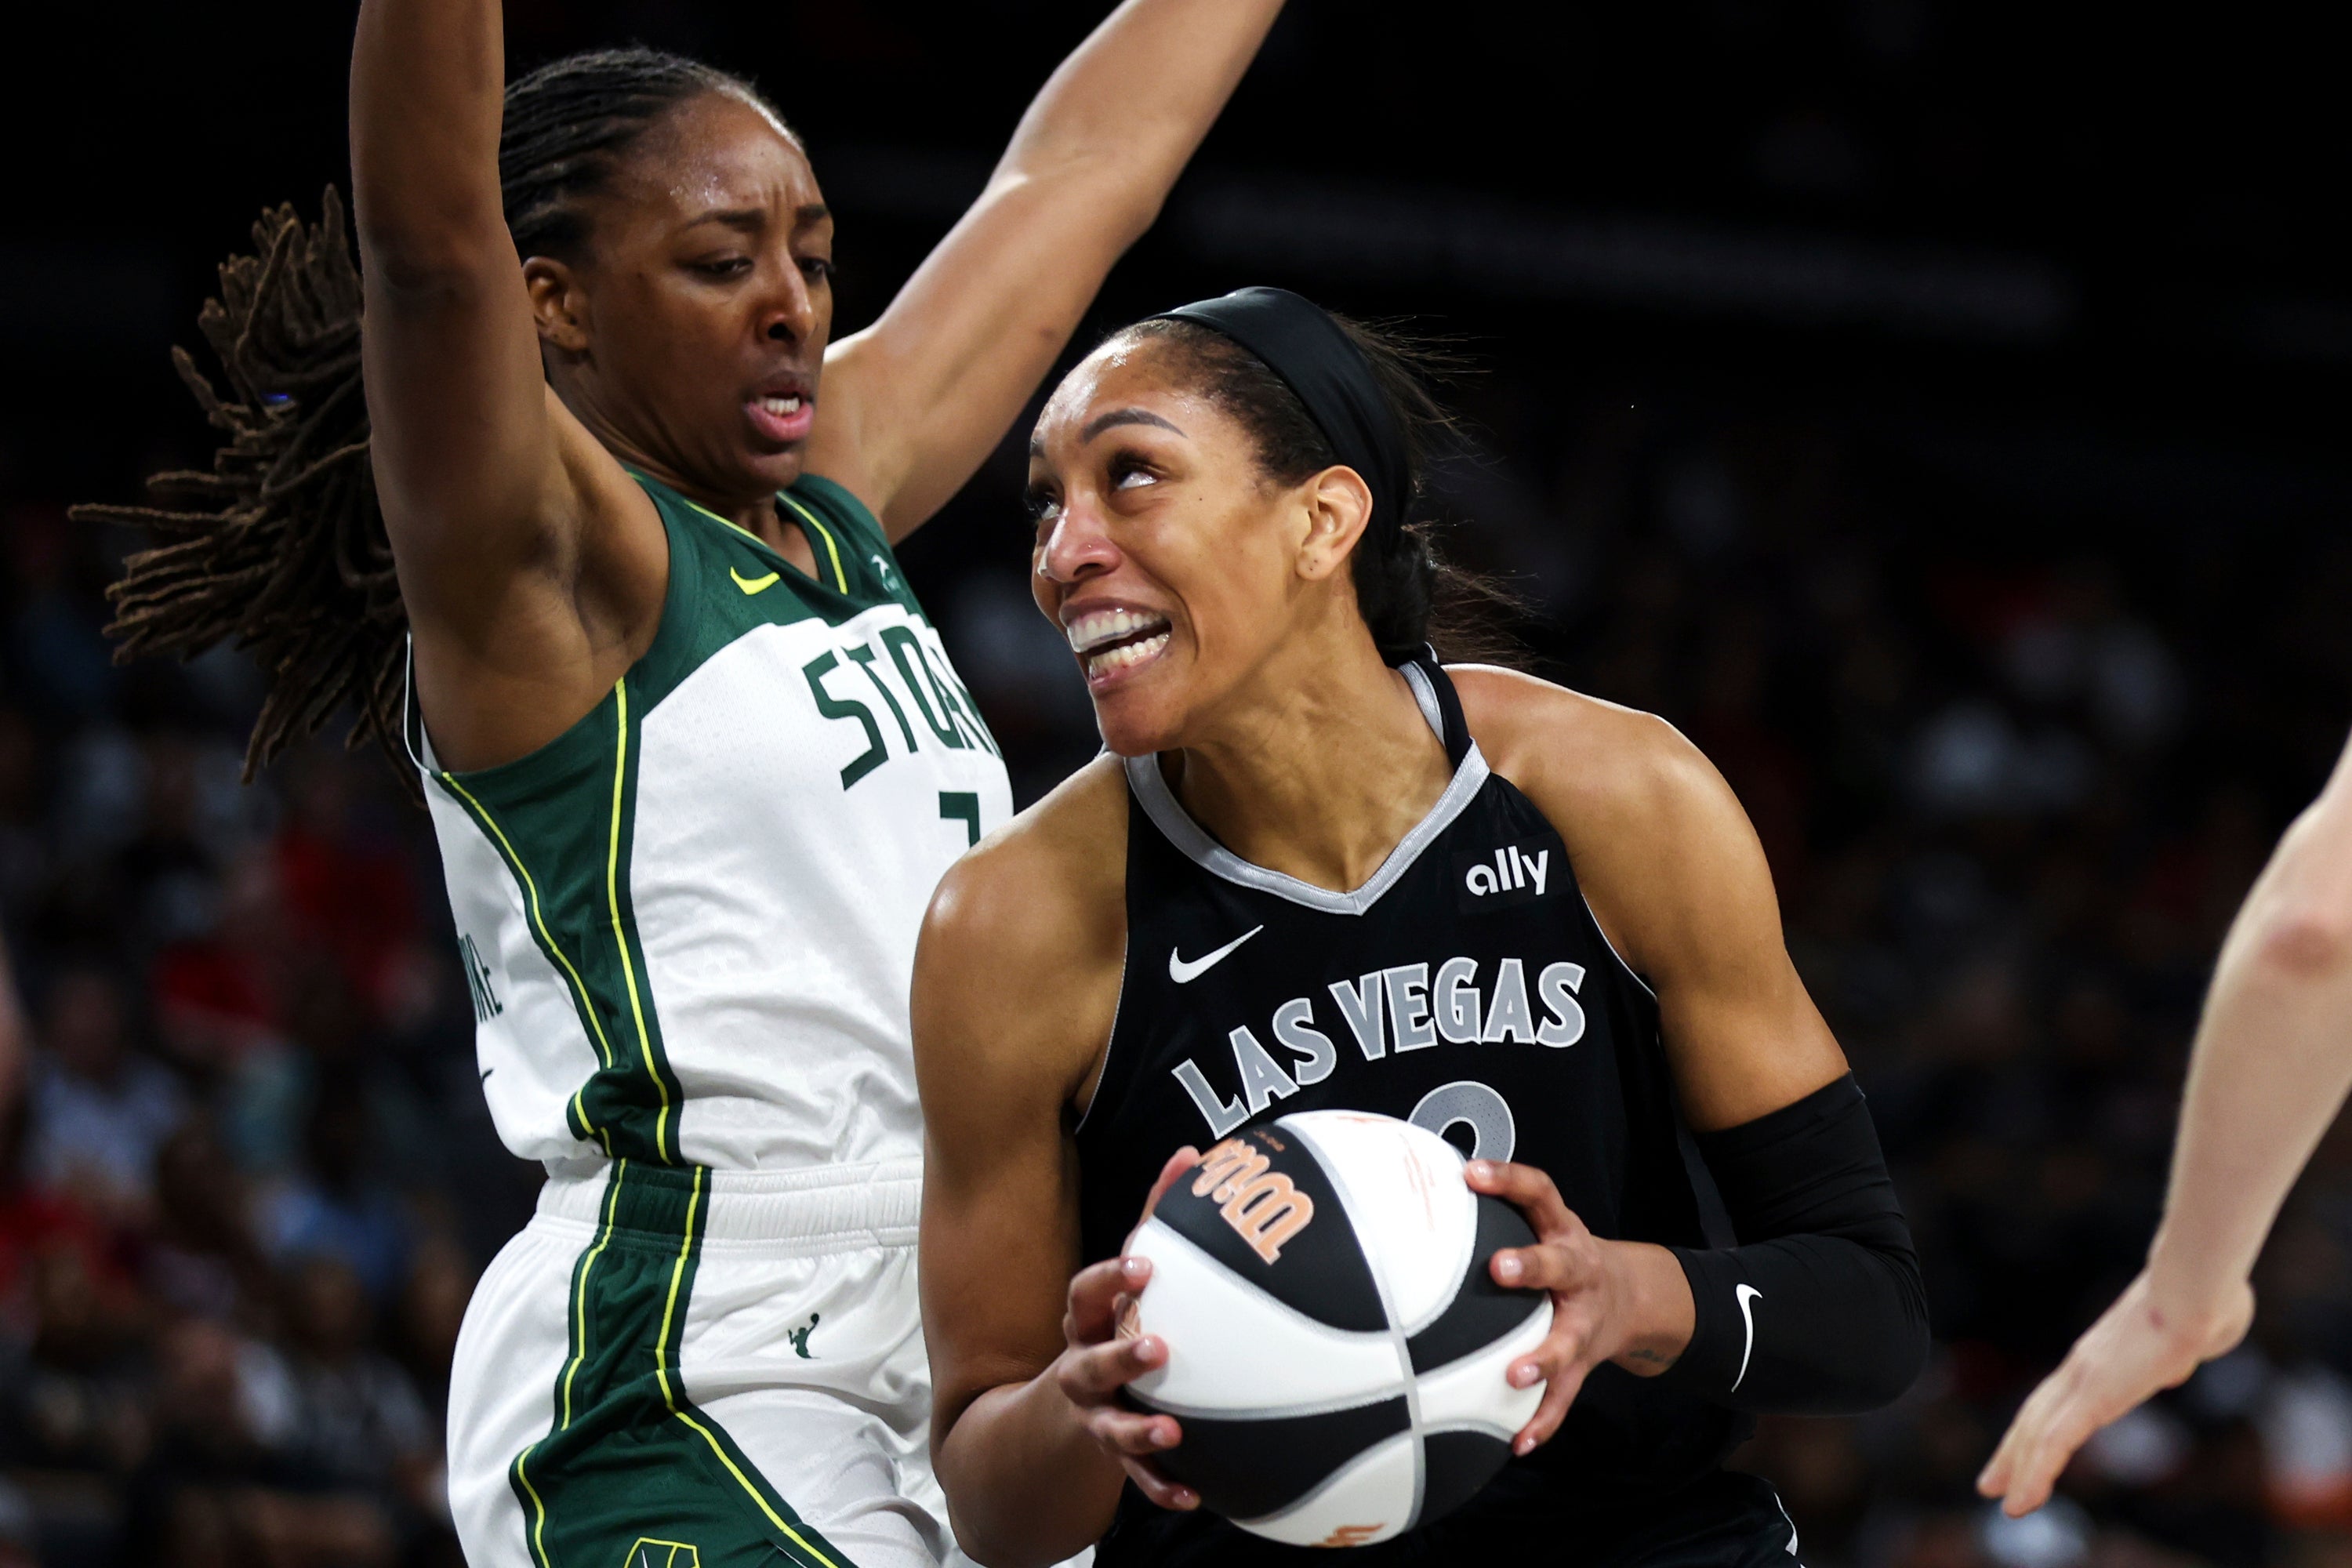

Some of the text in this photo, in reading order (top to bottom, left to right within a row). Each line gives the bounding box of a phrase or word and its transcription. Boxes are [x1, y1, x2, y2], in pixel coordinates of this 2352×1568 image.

[1465, 845, 1549, 896] ally
[1171, 997, 1337, 1141] LAS
[1328, 956, 1586, 1062] VEGAS
